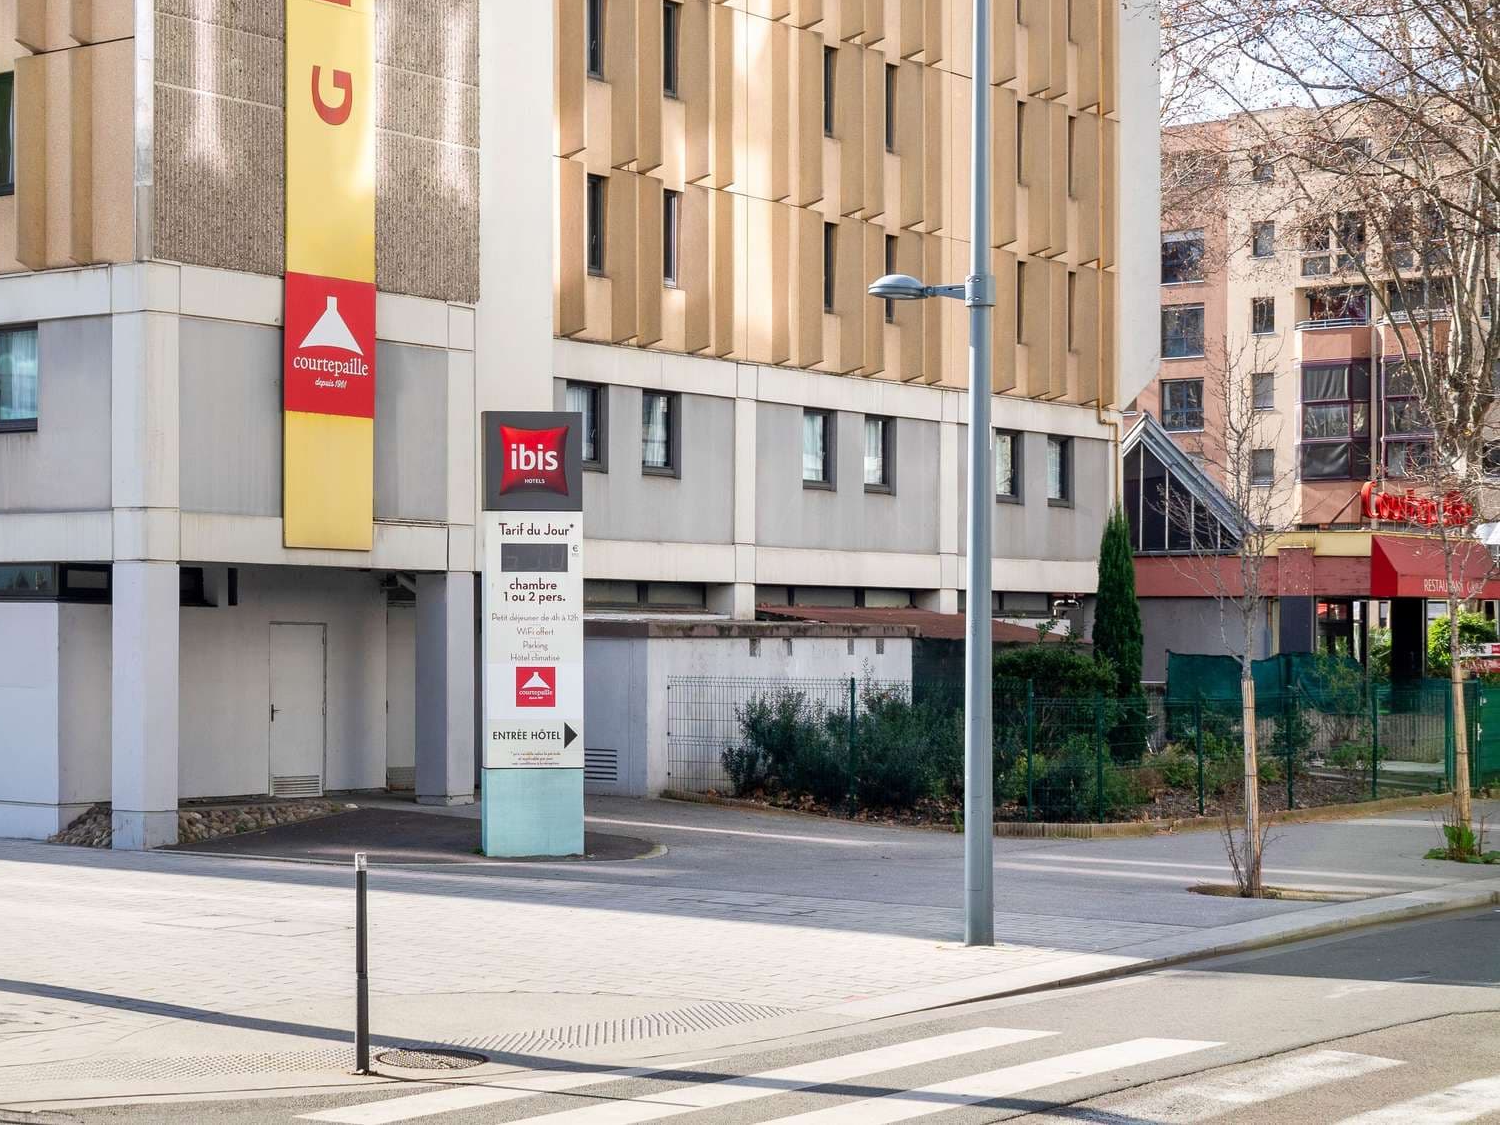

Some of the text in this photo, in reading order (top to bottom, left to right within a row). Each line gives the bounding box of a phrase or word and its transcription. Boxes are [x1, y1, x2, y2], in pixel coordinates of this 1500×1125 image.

[293, 356, 369, 376] courtepaille
[314, 377, 334, 387] depuis
[511, 443, 559, 470] ibis
[499, 522, 524, 536] Tarif
[527, 523, 540, 536] du
[572, 544, 579, 552] €
[509, 577, 557, 590] chambre
[1423, 578, 1464, 593] RESTAUANT
[504, 591, 566, 604] 1 ou 2 pers.
[491, 613, 508, 621] Petit
[540, 613, 550, 621] de
[522, 640, 549, 651] Parking
[510, 653, 530, 661] Hôtel
[492, 728, 562, 740] ENTRÉE HÔTEL
